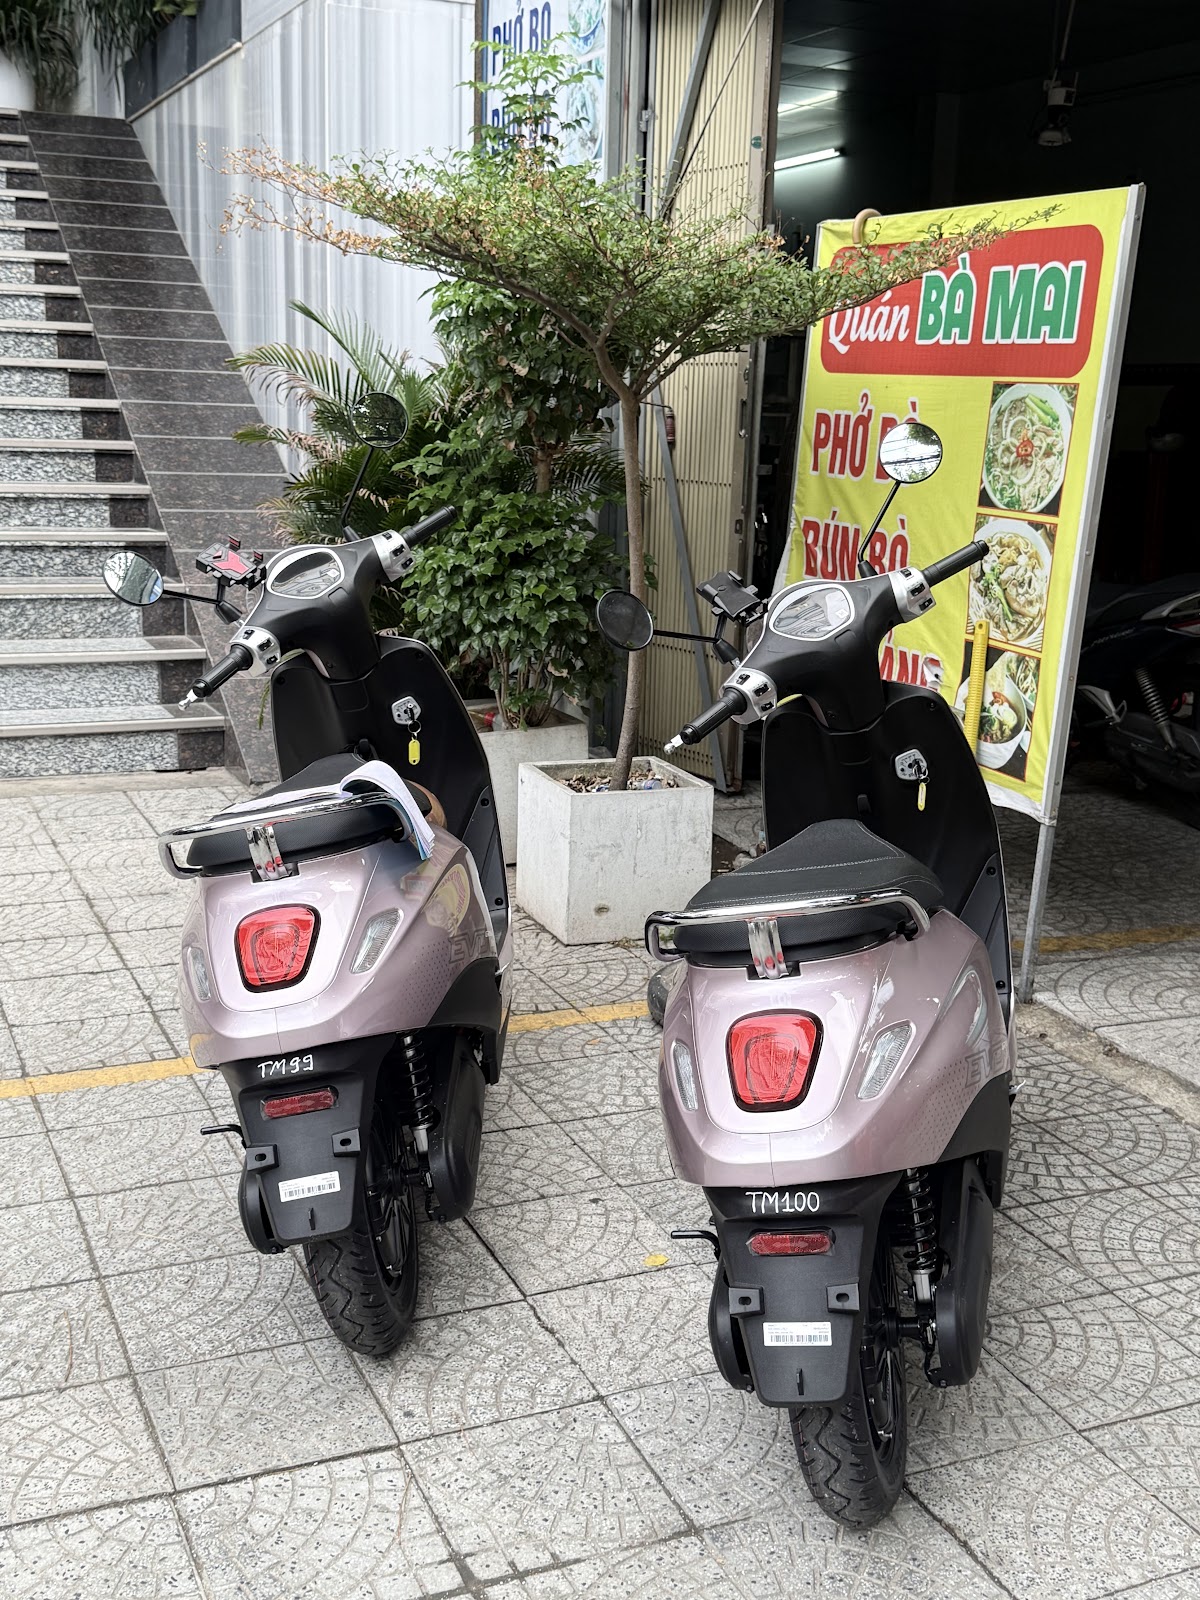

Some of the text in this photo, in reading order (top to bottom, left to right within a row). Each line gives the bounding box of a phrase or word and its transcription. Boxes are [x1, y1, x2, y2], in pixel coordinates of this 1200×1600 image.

[828, 253, 1086, 355] Quán BÀ MAI
[811, 391, 873, 480] PHỞ
[802, 509, 910, 581] BÚN BÒ
[257, 1054, 314, 1079] TM99
[745, 1191, 820, 1214] TM100
